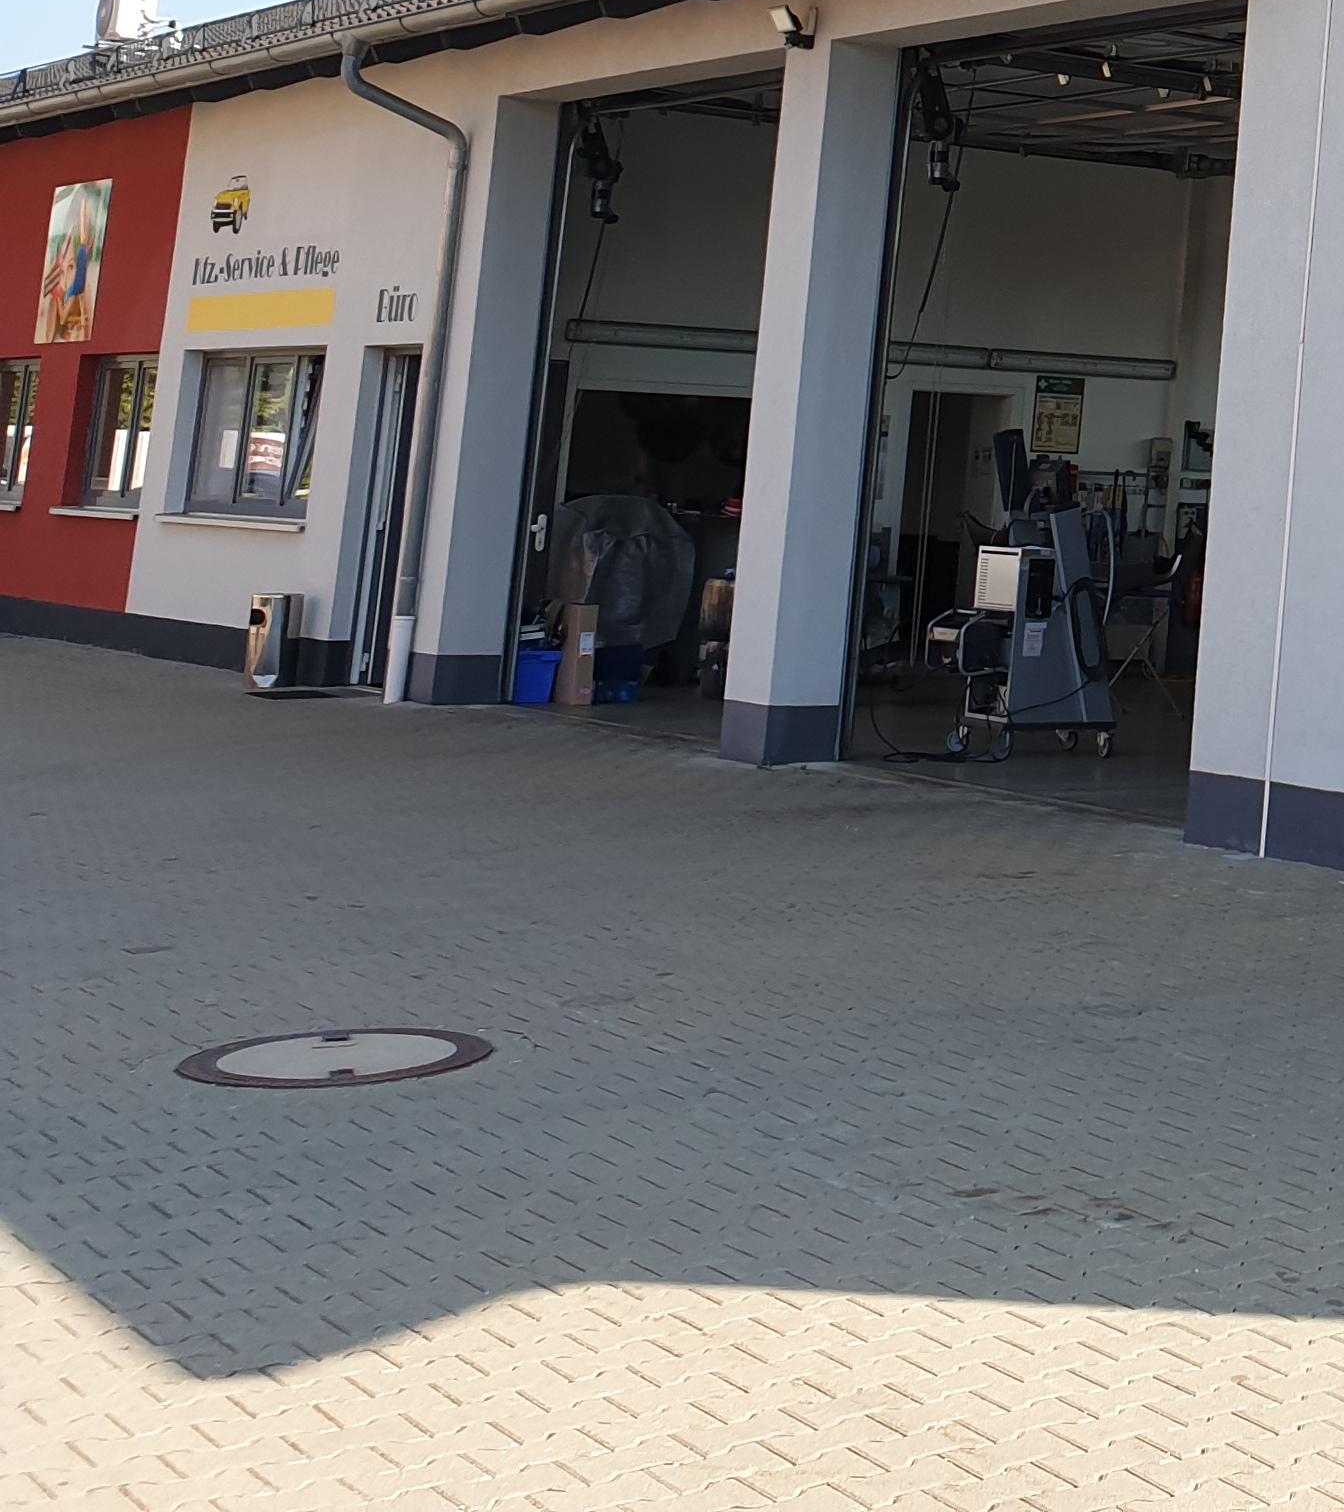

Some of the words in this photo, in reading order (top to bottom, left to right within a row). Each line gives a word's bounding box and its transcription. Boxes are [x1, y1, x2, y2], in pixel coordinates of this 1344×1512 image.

[278, 246, 291, 276] &
[293, 244, 340, 278] Pflege
[375, 285, 419, 323] Büro
